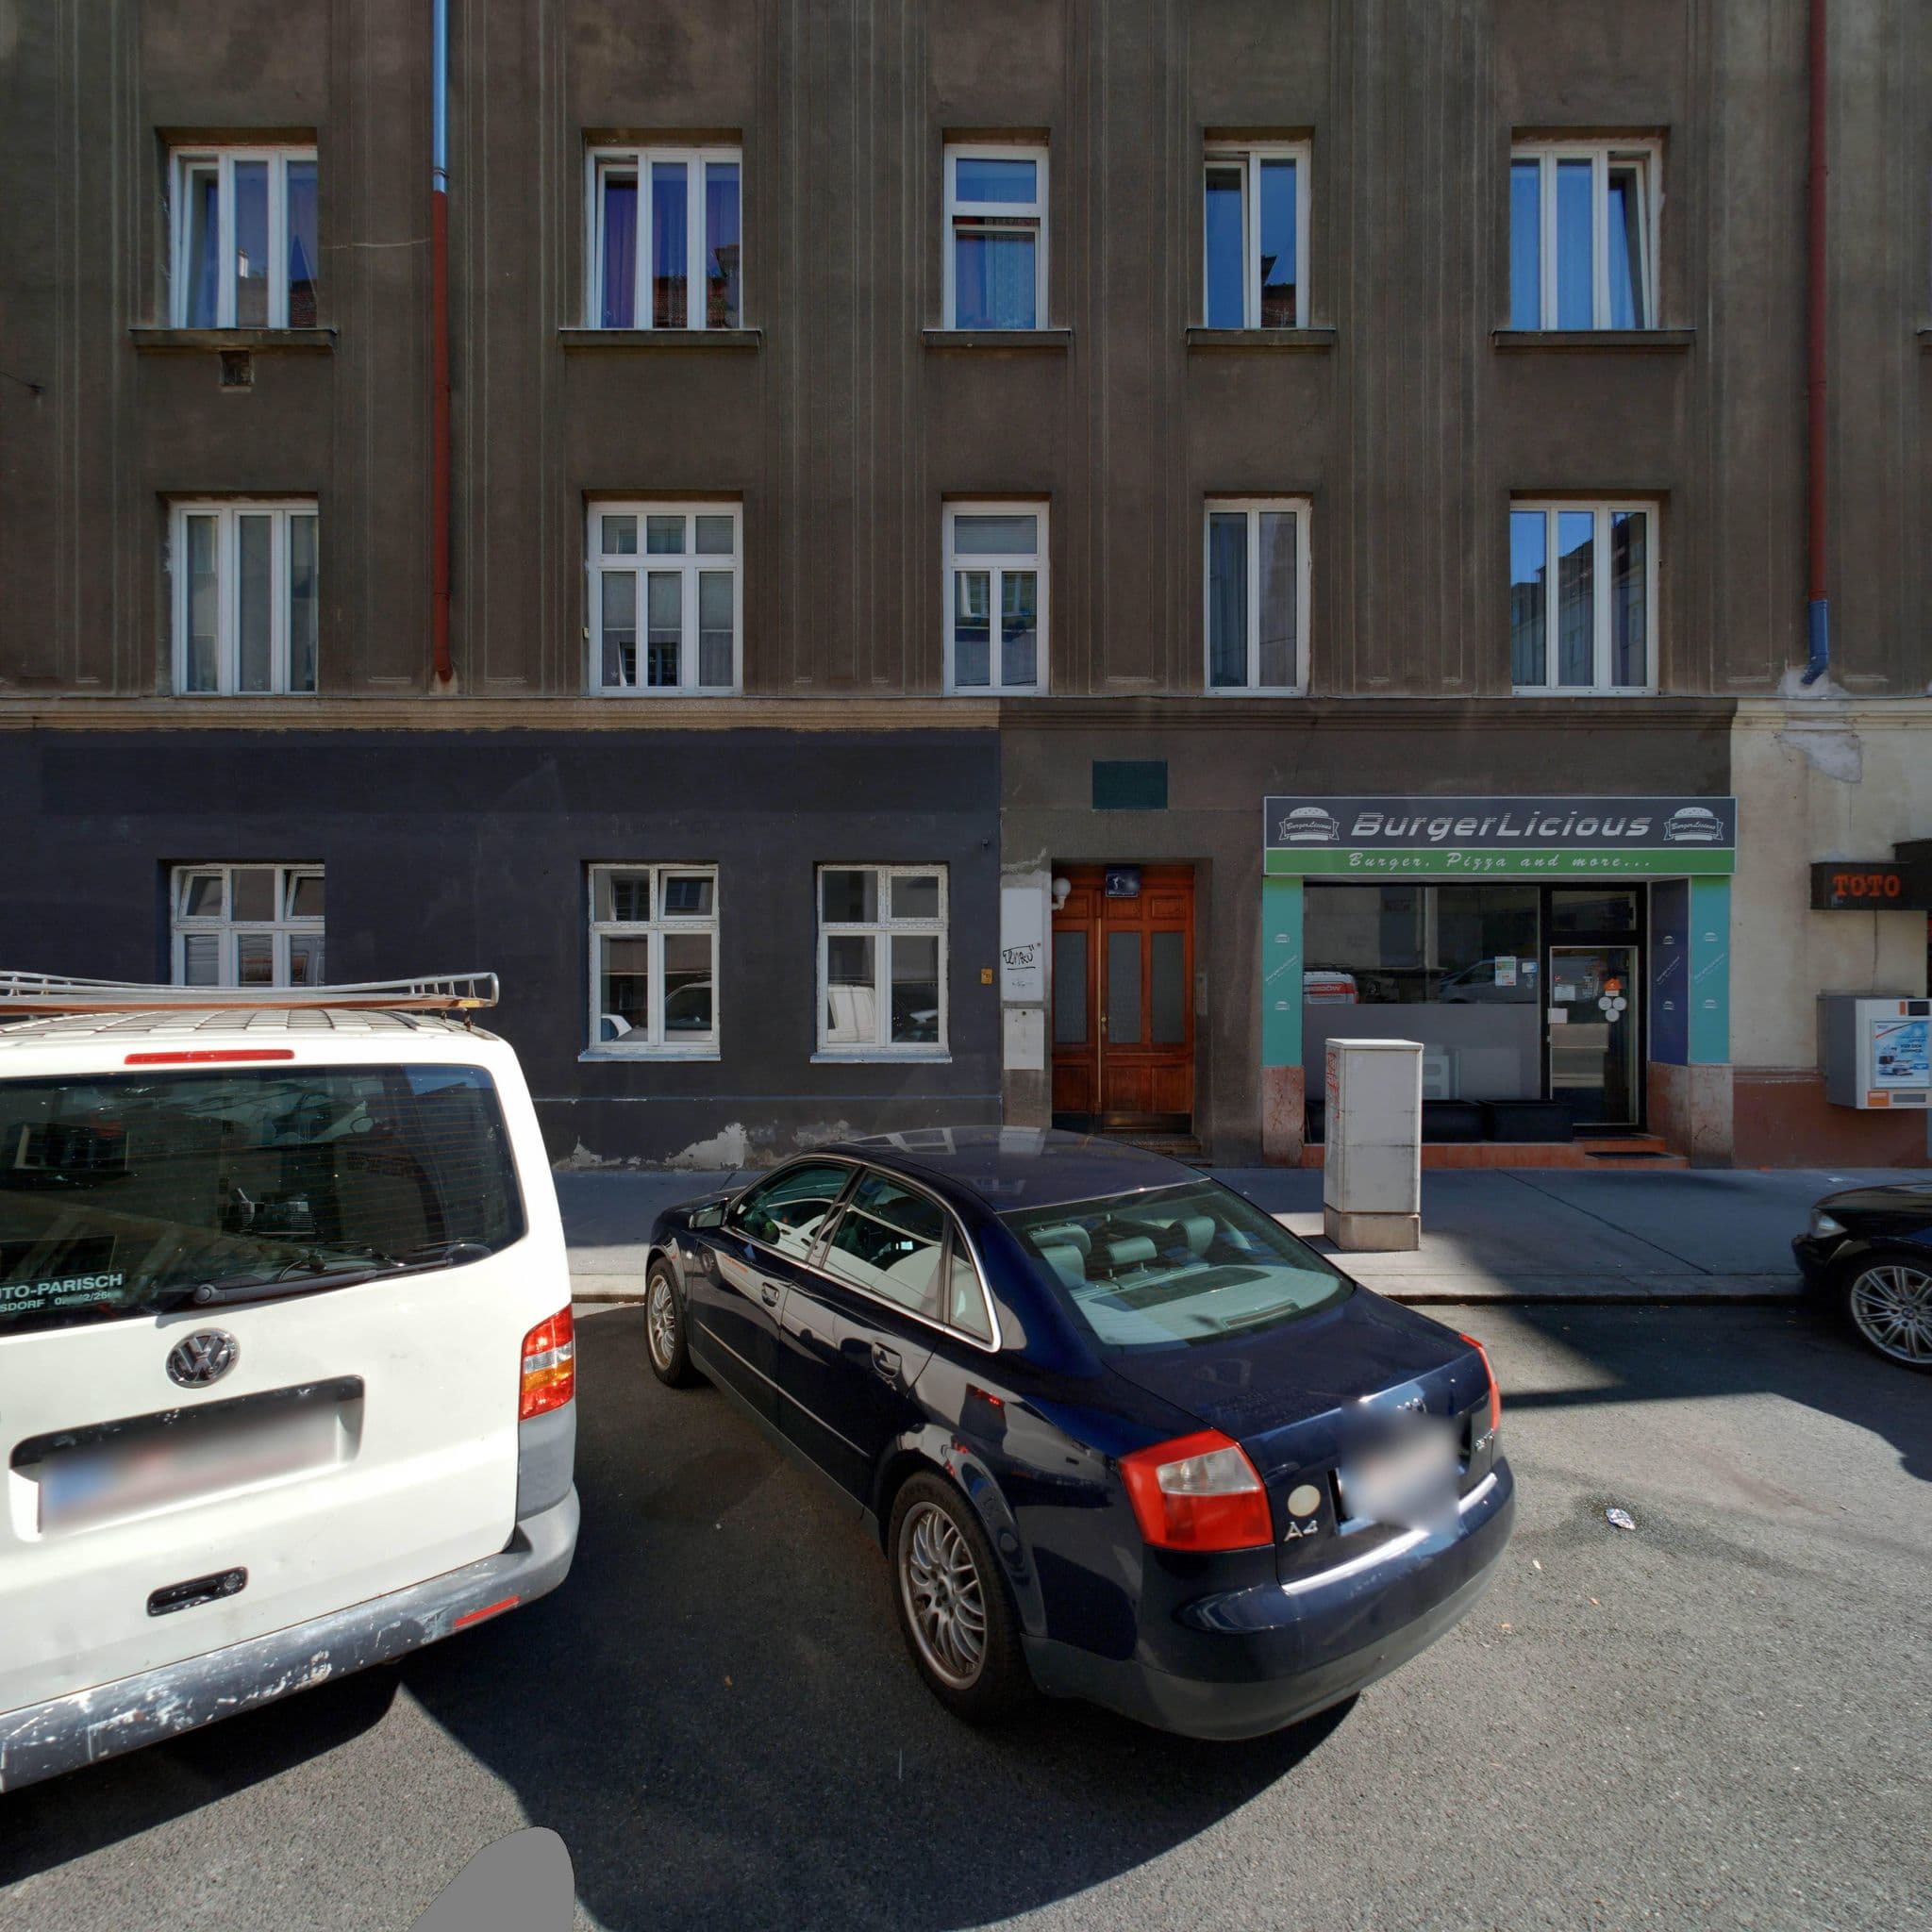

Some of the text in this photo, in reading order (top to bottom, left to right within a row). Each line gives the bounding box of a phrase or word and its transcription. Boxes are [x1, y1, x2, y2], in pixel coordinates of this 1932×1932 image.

[1350, 810, 1653, 841] BurgerLicious
[1446, 852, 1507, 871] Pizza
[1520, 854, 1560, 867] and
[1572, 856, 1651, 867] more...
[1832, 874, 1902, 898] TOTO
[0, 1273, 123, 1300] TO-PARISCH
[1283, 1519, 1319, 1541] A4
